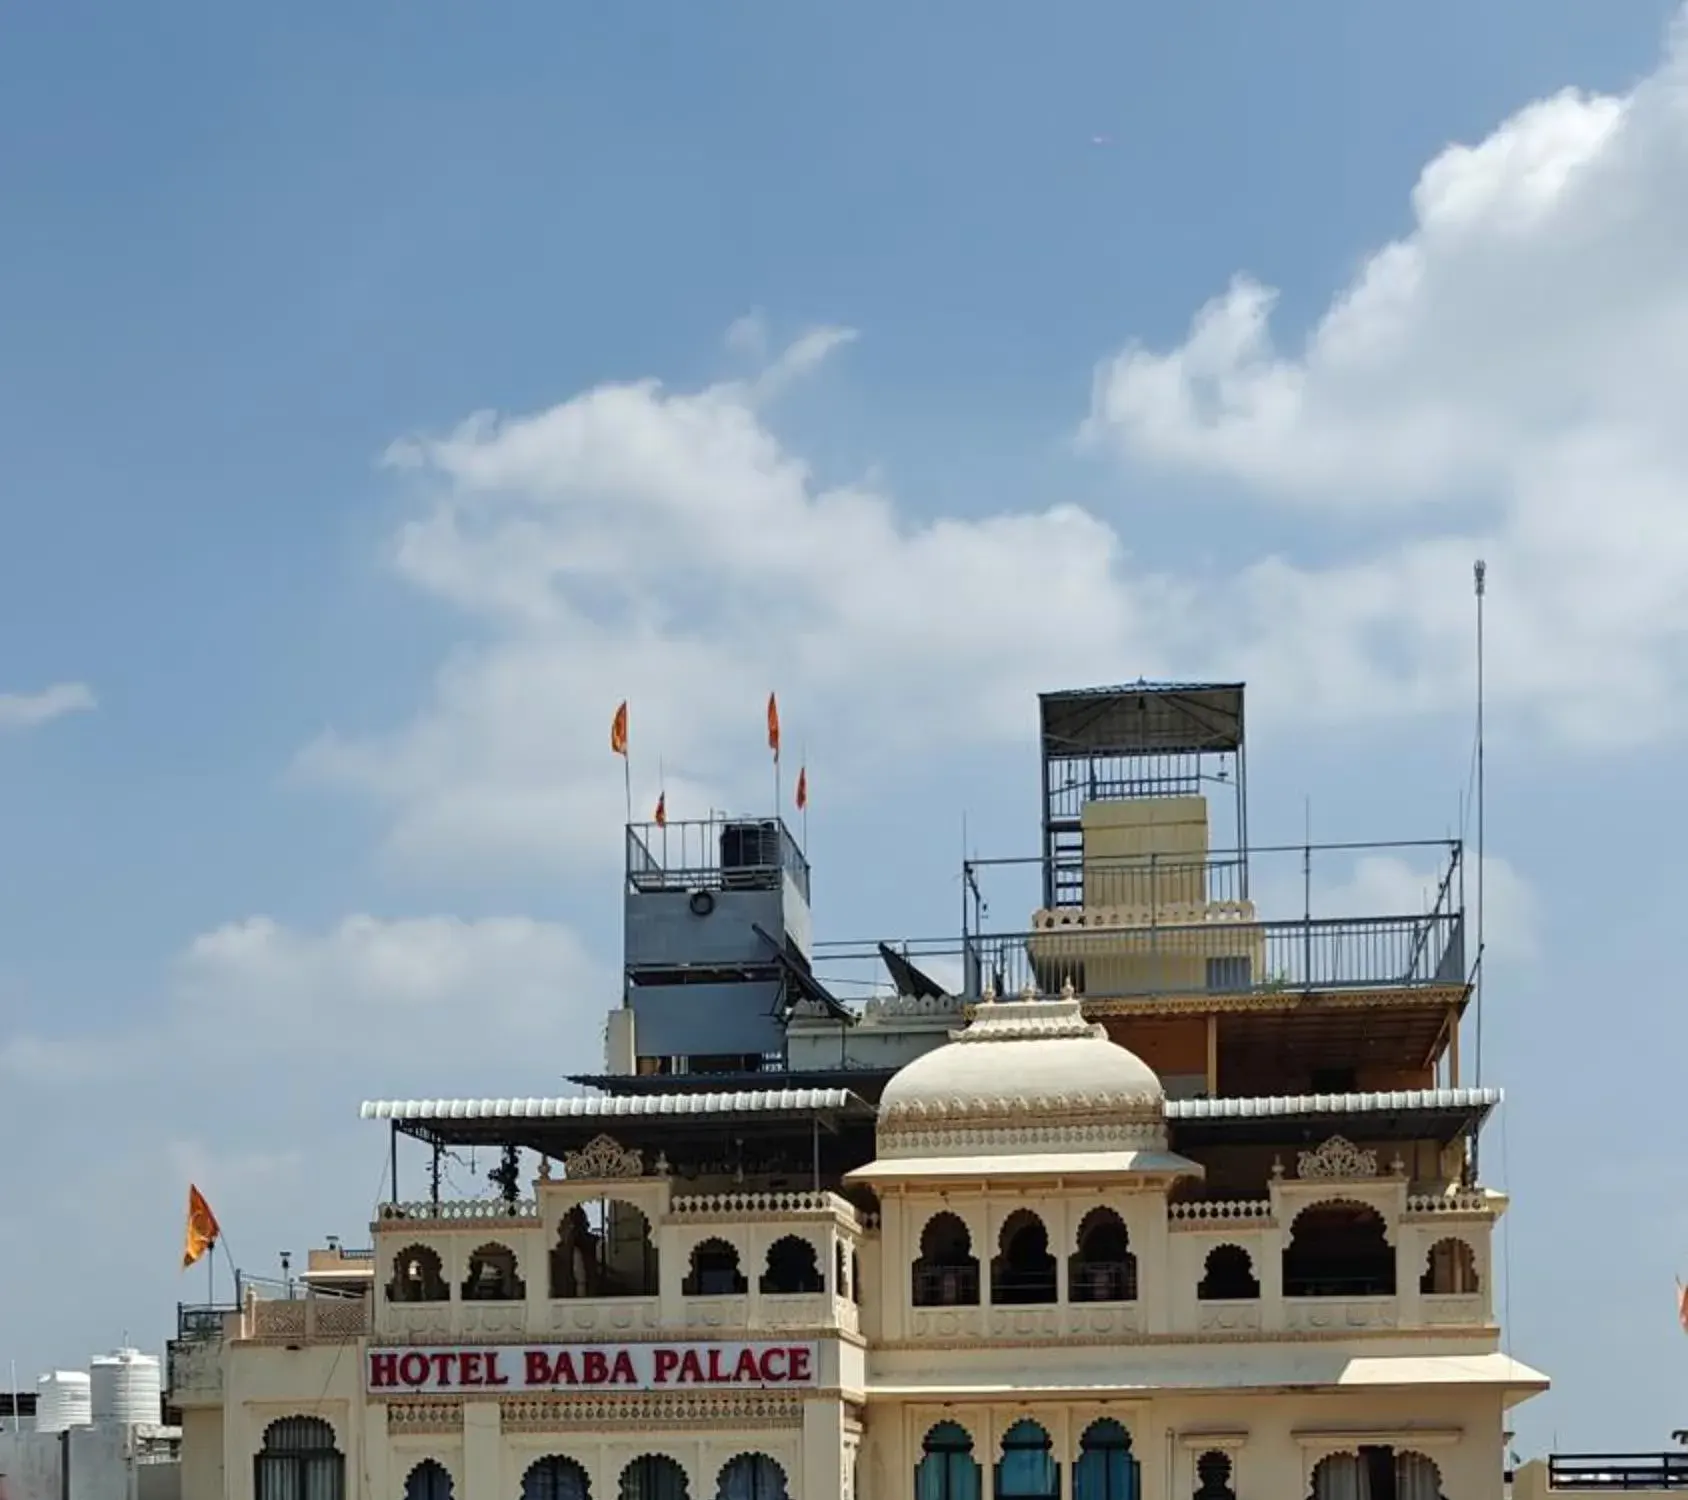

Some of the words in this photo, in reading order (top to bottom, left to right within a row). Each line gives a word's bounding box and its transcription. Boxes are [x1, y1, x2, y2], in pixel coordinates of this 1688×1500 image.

[370, 1351, 508, 1387] HOTEL
[523, 1351, 637, 1385] BABA
[653, 1347, 811, 1382] PALACE
